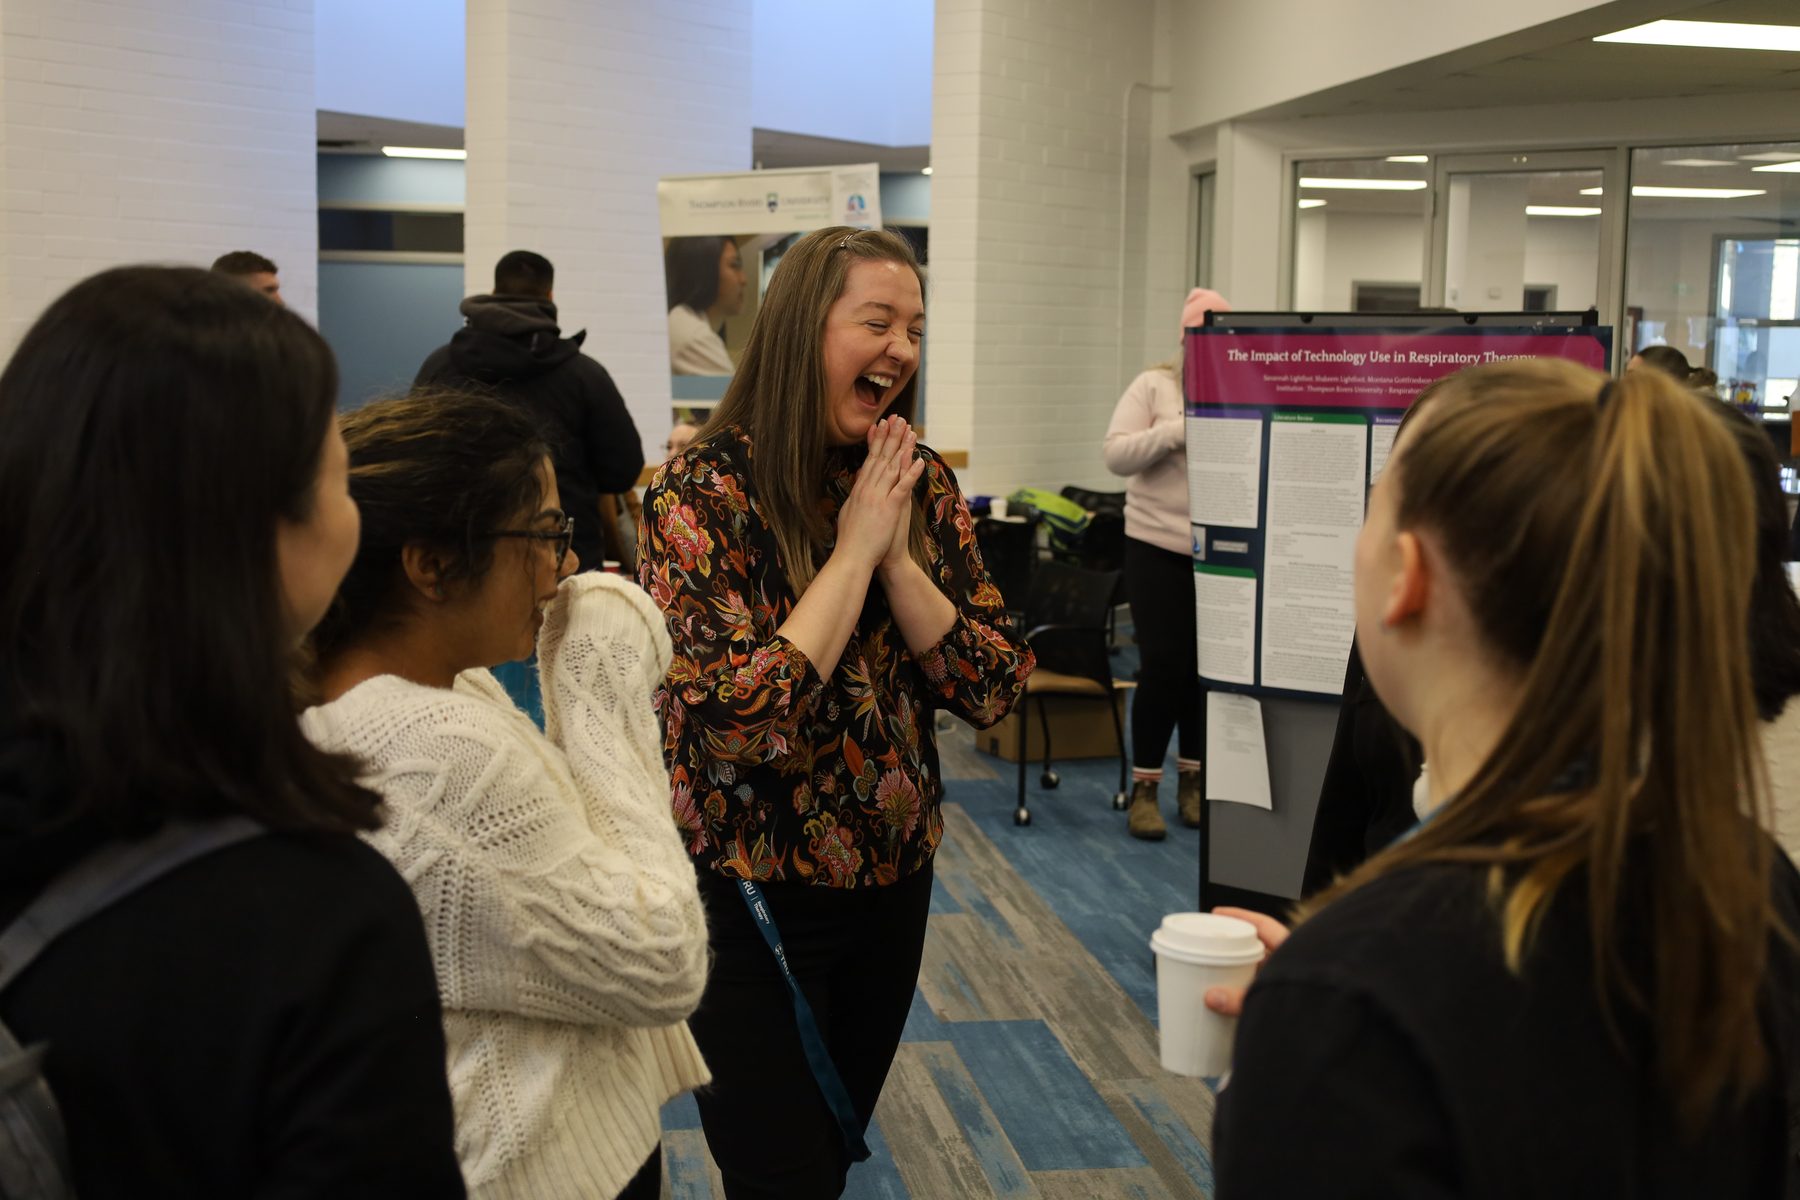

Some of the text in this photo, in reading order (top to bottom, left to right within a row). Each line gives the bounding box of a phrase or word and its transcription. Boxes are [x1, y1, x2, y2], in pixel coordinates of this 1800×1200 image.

[1227, 349, 1249, 362] The
[1250, 350, 1289, 365] Impact
[1291, 350, 1302, 362] of
[1303, 350, 1367, 366] Technology
[1369, 351, 1391, 363] Use
[1394, 351, 1406, 363] in
[1408, 351, 1481, 367] Respiratory
[741, 879, 756, 896] RU
[780, 953, 790, 975] TRU
